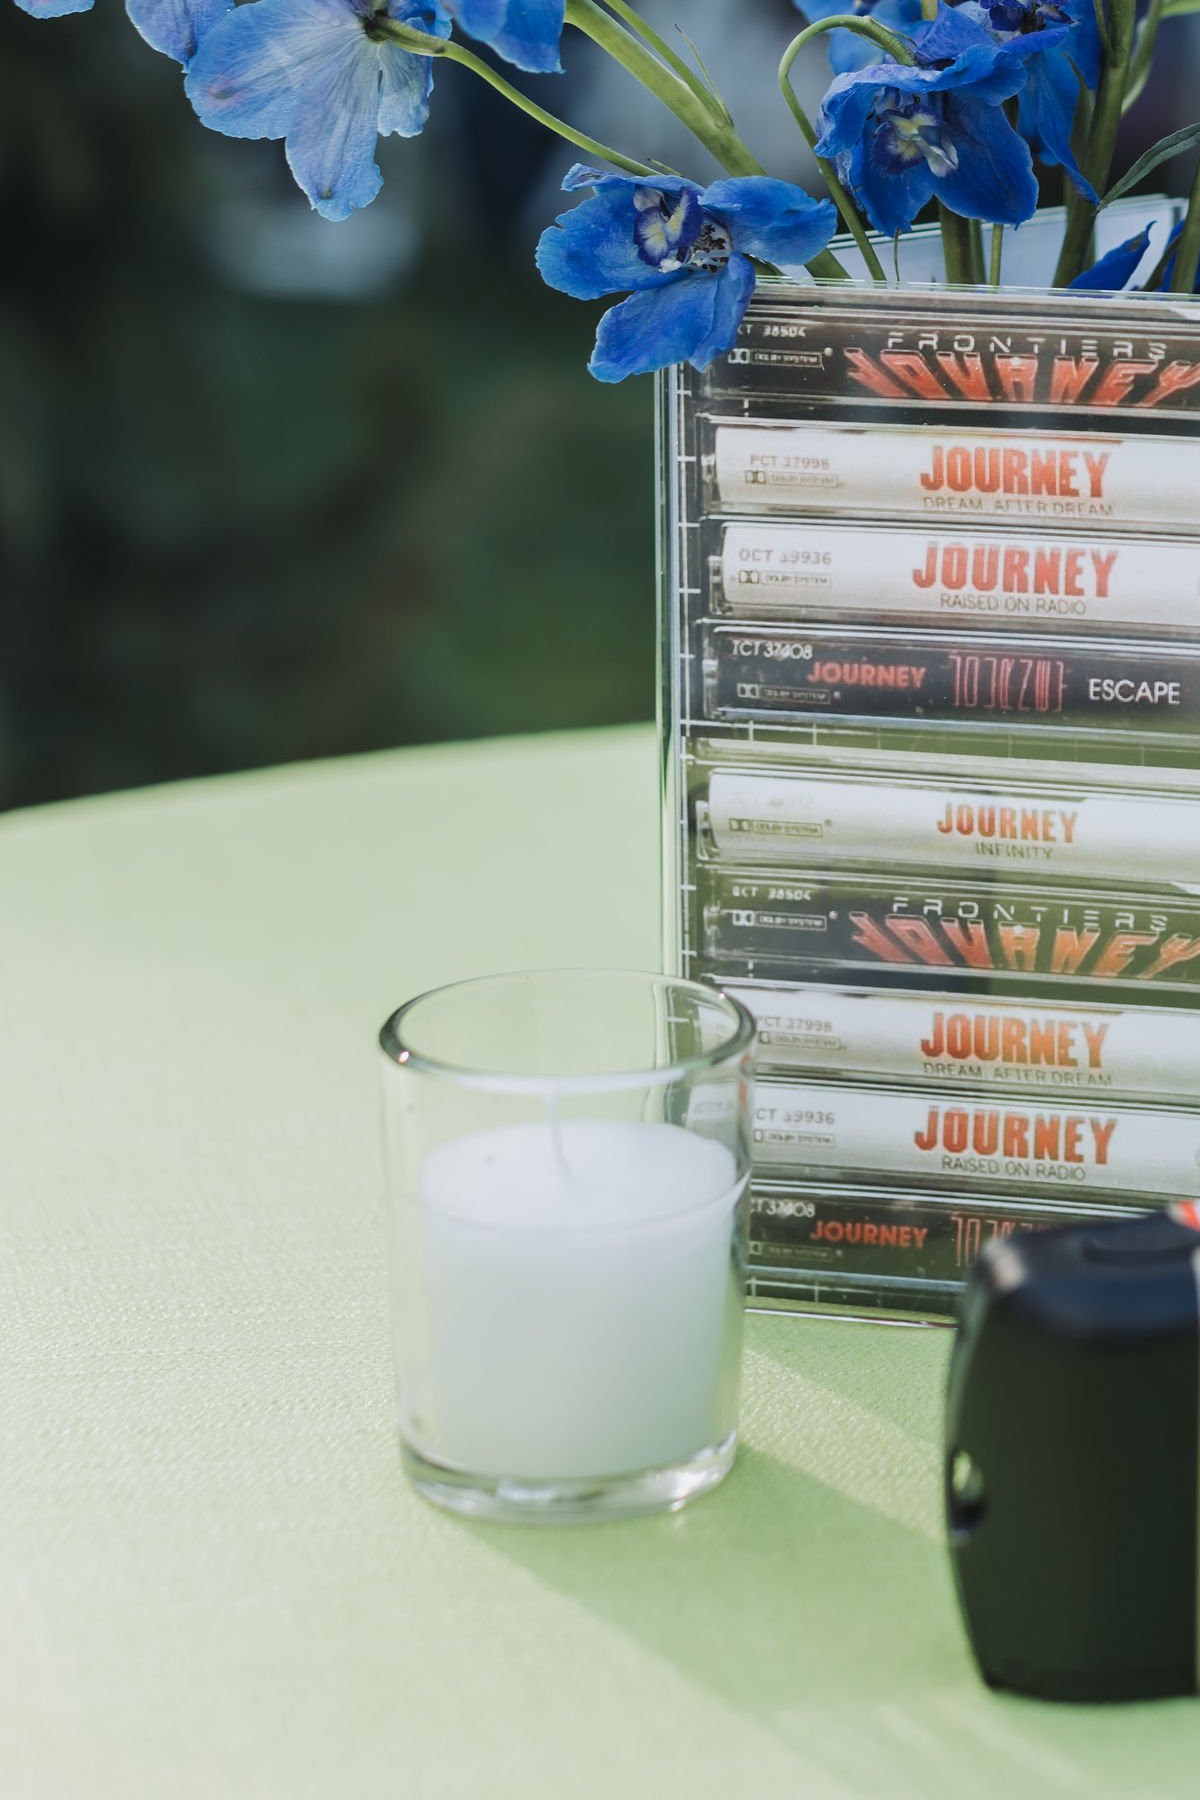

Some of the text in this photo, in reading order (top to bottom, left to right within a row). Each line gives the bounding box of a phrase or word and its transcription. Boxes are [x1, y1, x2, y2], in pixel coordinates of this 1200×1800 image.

[888, 331, 1168, 360] FRONTIERS
[920, 444, 1110, 498] JOURNEY
[993, 499, 1046, 515] AFTER
[1052, 502, 1114, 517] DREAM
[912, 541, 1119, 597] JOURNEY
[940, 593, 1087, 616] RAISED ON RADIO
[807, 661, 927, 689] JOURNEY
[1088, 678, 1181, 704] ESCAPE
[937, 802, 1078, 843] JOURNEY
[975, 841, 1053, 860] INFINITY
[892, 896, 1169, 932] FRONTIERS
[920, 1012, 1110, 1068] JOURNEY
[993, 1067, 1046, 1083] AFTER
[1051, 1071, 1113, 1087] DREAM
[914, 1105, 1118, 1165] JOURNEY
[941, 1155, 1086, 1181] RAISED ON RADIO
[810, 1220, 928, 1248] JOURNEY
